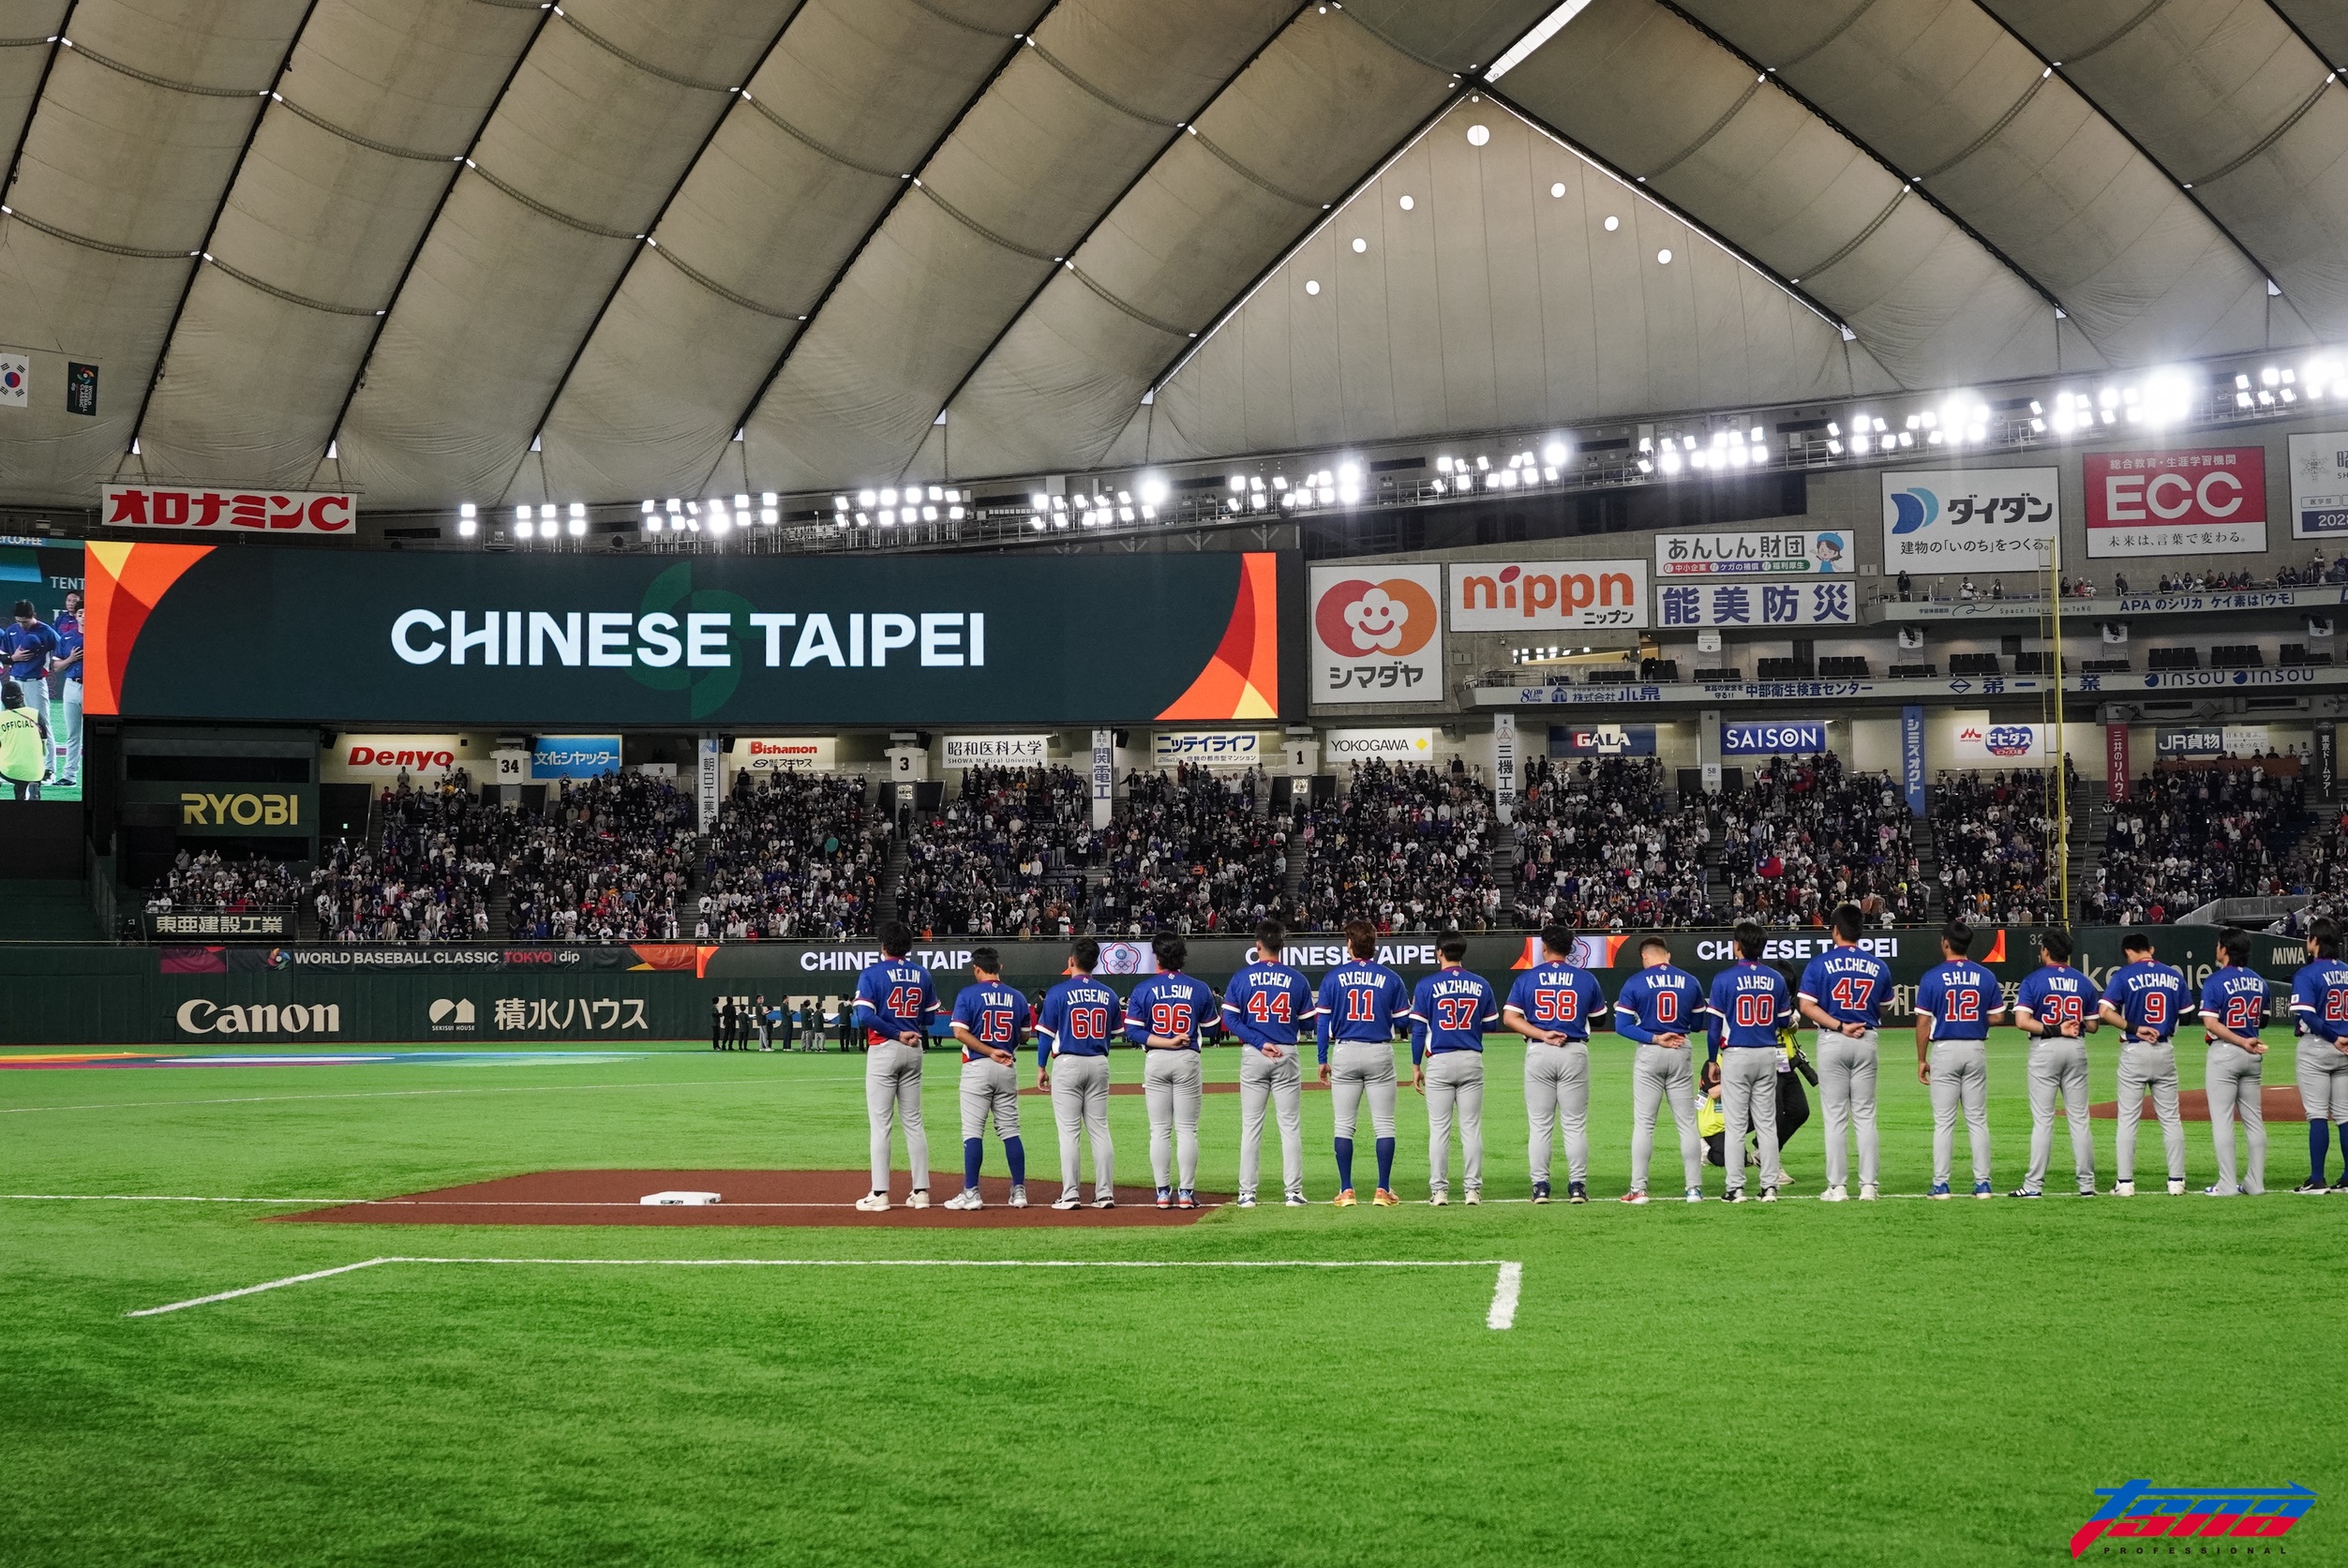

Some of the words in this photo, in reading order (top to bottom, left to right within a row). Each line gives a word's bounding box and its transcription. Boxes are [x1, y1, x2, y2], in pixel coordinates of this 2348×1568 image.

[2110, 455, 2236, 470] 総合教育・生涯学習機関
[2106, 471, 2243, 520] ECC
[110, 490, 350, 531] オロナミンC
[1948, 493, 2053, 525] ダイダン
[1668, 534, 1805, 560] あんしん財団
[1900, 538, 2050, 555] 建物の「いのち」をつくる。
[2108, 531, 2246, 548] 未来は、言葉で変わる。
[1675, 563, 1706, 572] 中小企業
[1720, 562, 1759, 571] ケガの補償
[1772, 561, 1805, 570] 福利厚生
[1463, 565, 1634, 617] nippn
[1663, 584, 1849, 624] 能美防災
[1584, 611, 1634, 625] ニップン
[391, 609, 731, 667] CHINESE
[750, 611, 985, 667] TAIPEI
[1330, 661, 1424, 689] シマダヤ
[1573, 693, 1616, 703] 株式会社
[1618, 686, 1661, 701] 小泉
[1746, 681, 1874, 698] 中部衛生検査センター
[1, 720, 34, 732] OFFICIAL
[751, 741, 817, 754] Bishamon
[948, 740, 1041, 755] 昭和医科大学
[1158, 735, 1256, 753] ニッテイライフ
[1331, 739, 1409, 752] YOKOGAWA
[1577, 732, 1632, 747] GALA
[1727, 728, 1817, 748] SAISON
[1986, 733, 2032, 746] ビヒダス
[2159, 733, 2221, 751] JR貨物
[348, 747, 455, 771] Denyo
[501, 758, 519, 774] 34
[533, 751, 620, 767] 文化シャッター
[779, 758, 813, 768] スギヤス
[900, 756, 909, 771] 3
[1296, 751, 1304, 765] 1
[1907, 719, 1921, 795] シミズオクト
[2113, 731, 2125, 803] 三井のリハウス
[2321, 735, 2331, 798] 東京ドームツアー
[1093, 747, 1111, 799] 関電工
[1498, 745, 1513, 806] 三機工業
[703, 757, 715, 829] 朝日工業社
[181, 794, 298, 828] RYOBI
[156, 916, 283, 933] 東亜建設工業
[294, 952, 351, 964] WORLD
[353, 952, 431, 963] BASEBALL
[434, 951, 499, 963] CLASSIC
[504, 950, 553, 963] TOKYO
[559, 950, 580, 963] dip
[1245, 946, 1353, 966] CINESE
[1697, 939, 1812, 961] CHESE
[2272, 947, 2306, 964] MIWA
[887, 968, 920, 983] W.E.LIN
[1824, 957, 1880, 978] H.C.CHENG
[1249, 972, 1292, 989] P.Y.CHEN
[1338, 971, 1386, 989] R.Y.GULIN
[1432, 979, 1483, 998] J.W.ZHANG
[1539, 972, 1574, 986] C.W.HU
[1646, 975, 1685, 989] K.W.LIN
[1736, 975, 1774, 991] J.H.HSU
[1942, 971, 1981, 986] S.H.LIN
[2128, 973, 2179, 992] C.Y.CHANG
[2223, 977, 2264, 995] C.H.CHEN
[887, 986, 922, 1018] 42
[980, 993, 1013, 1008] T.W.LIN
[1067, 989, 1110, 1006] J.Y.TSENG
[1151, 985, 1192, 1000] Y.L.SUN
[1832, 977, 1875, 1010] 47
[494, 998, 649, 1031] 積水ハウス
[1247, 991, 1292, 1023] 44
[1347, 989, 1375, 1022] 11
[1438, 998, 1478, 1030] 37
[1534, 989, 1578, 1022] 58
[1657, 991, 1678, 1023] 0
[1736, 993, 1774, 1027] 00
[1945, 989, 1980, 1022] 12
[2041, 994, 2083, 1025] 39
[2145, 992, 2166, 1023] 9
[2226, 996, 2263, 1028] 24
[176, 998, 339, 1034] Canon
[980, 1010, 1013, 1042] 15
[1070, 1008, 1108, 1039] 60
[1152, 1003, 1192, 1035] 96
